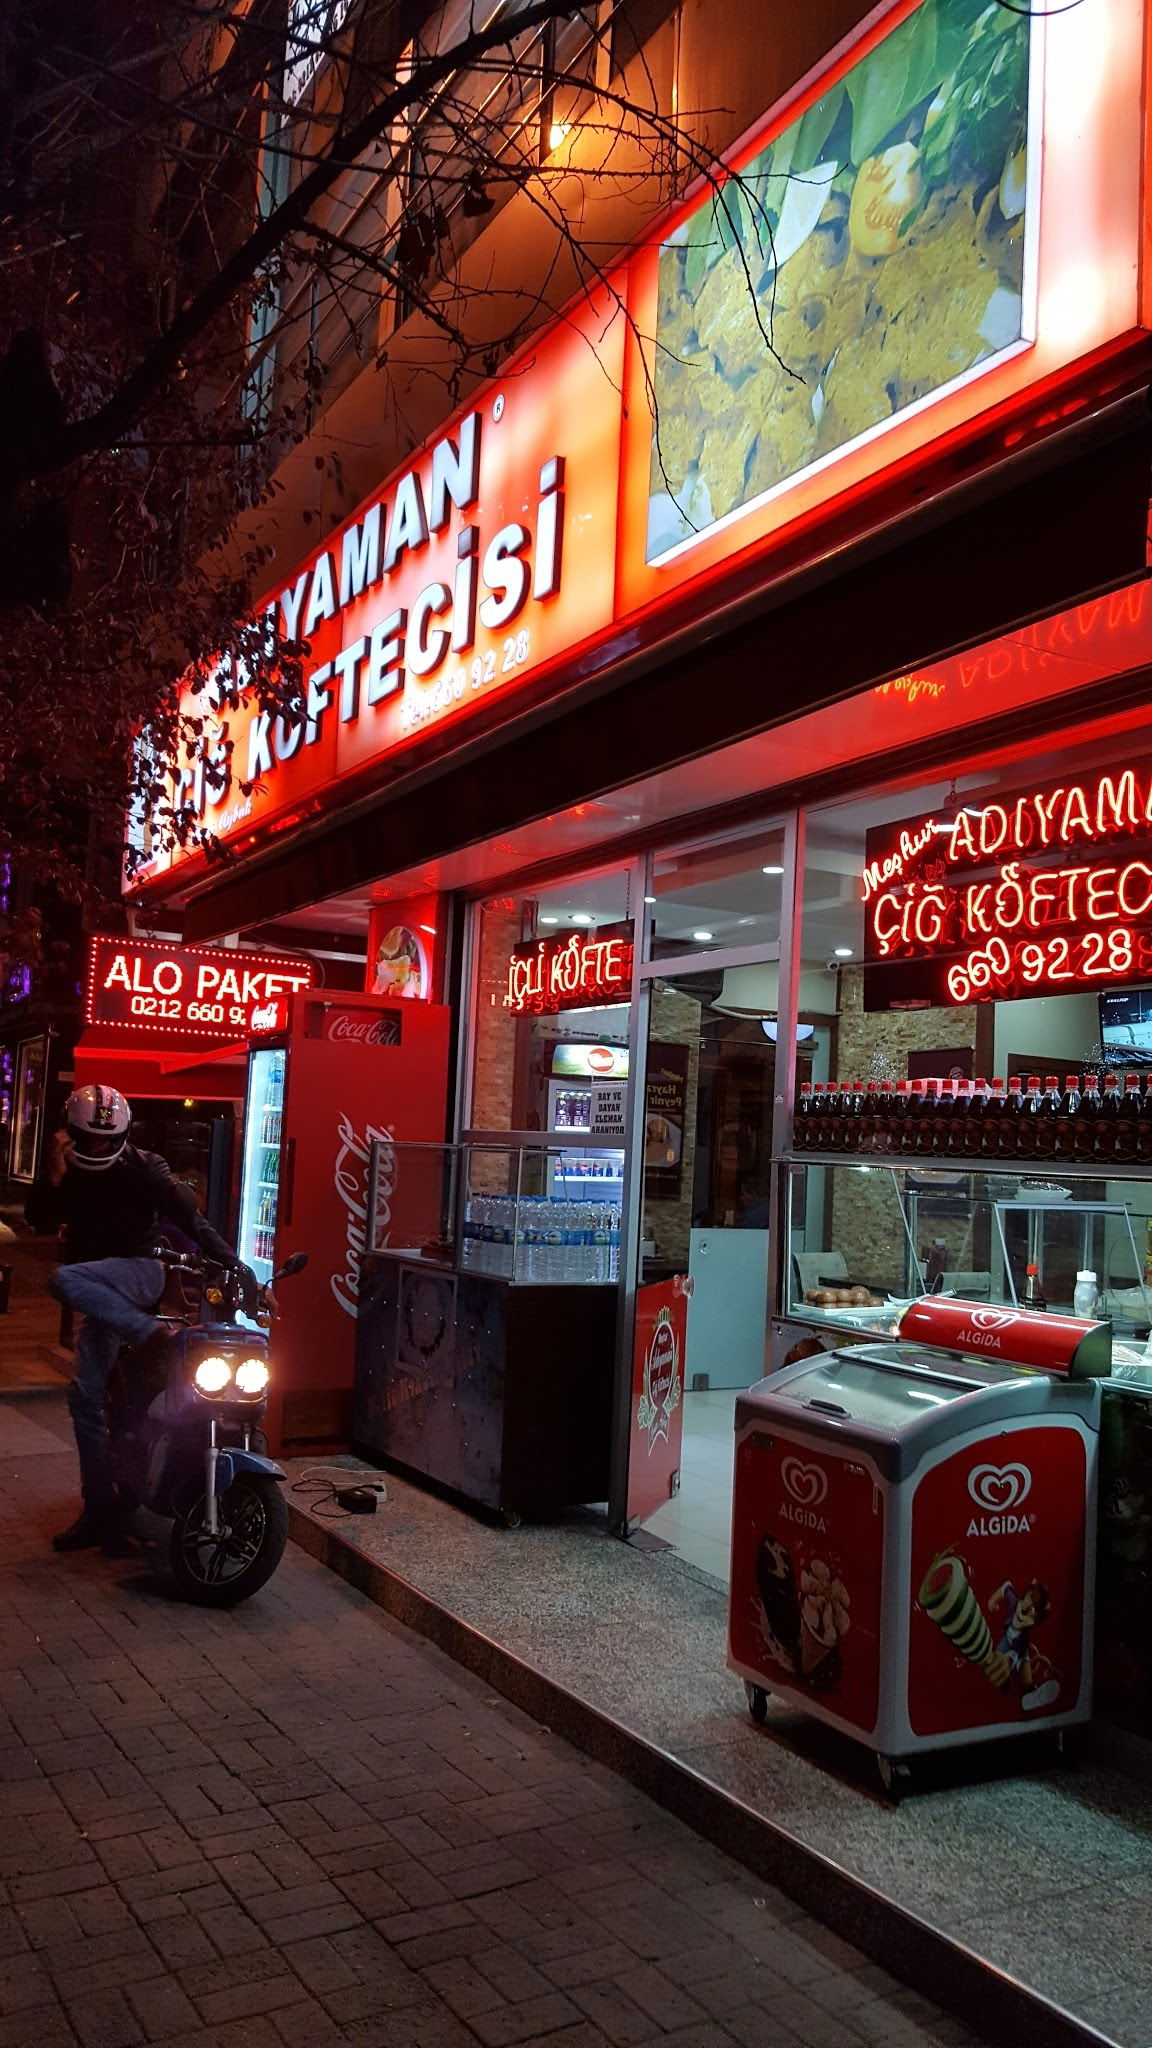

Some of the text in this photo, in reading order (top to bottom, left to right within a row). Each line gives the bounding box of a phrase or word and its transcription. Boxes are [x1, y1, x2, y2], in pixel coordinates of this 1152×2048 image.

[471, 649, 497, 690] 92
[501, 628, 530, 673] 28
[874, 883, 947, 955] ÇİĞ
[104, 954, 183, 994] ALO
[550, 934, 624, 994] KÖFTE
[947, 936, 1011, 1001] 660
[131, 996, 180, 1019] 0212
[187, 1000, 224, 1023] 660
